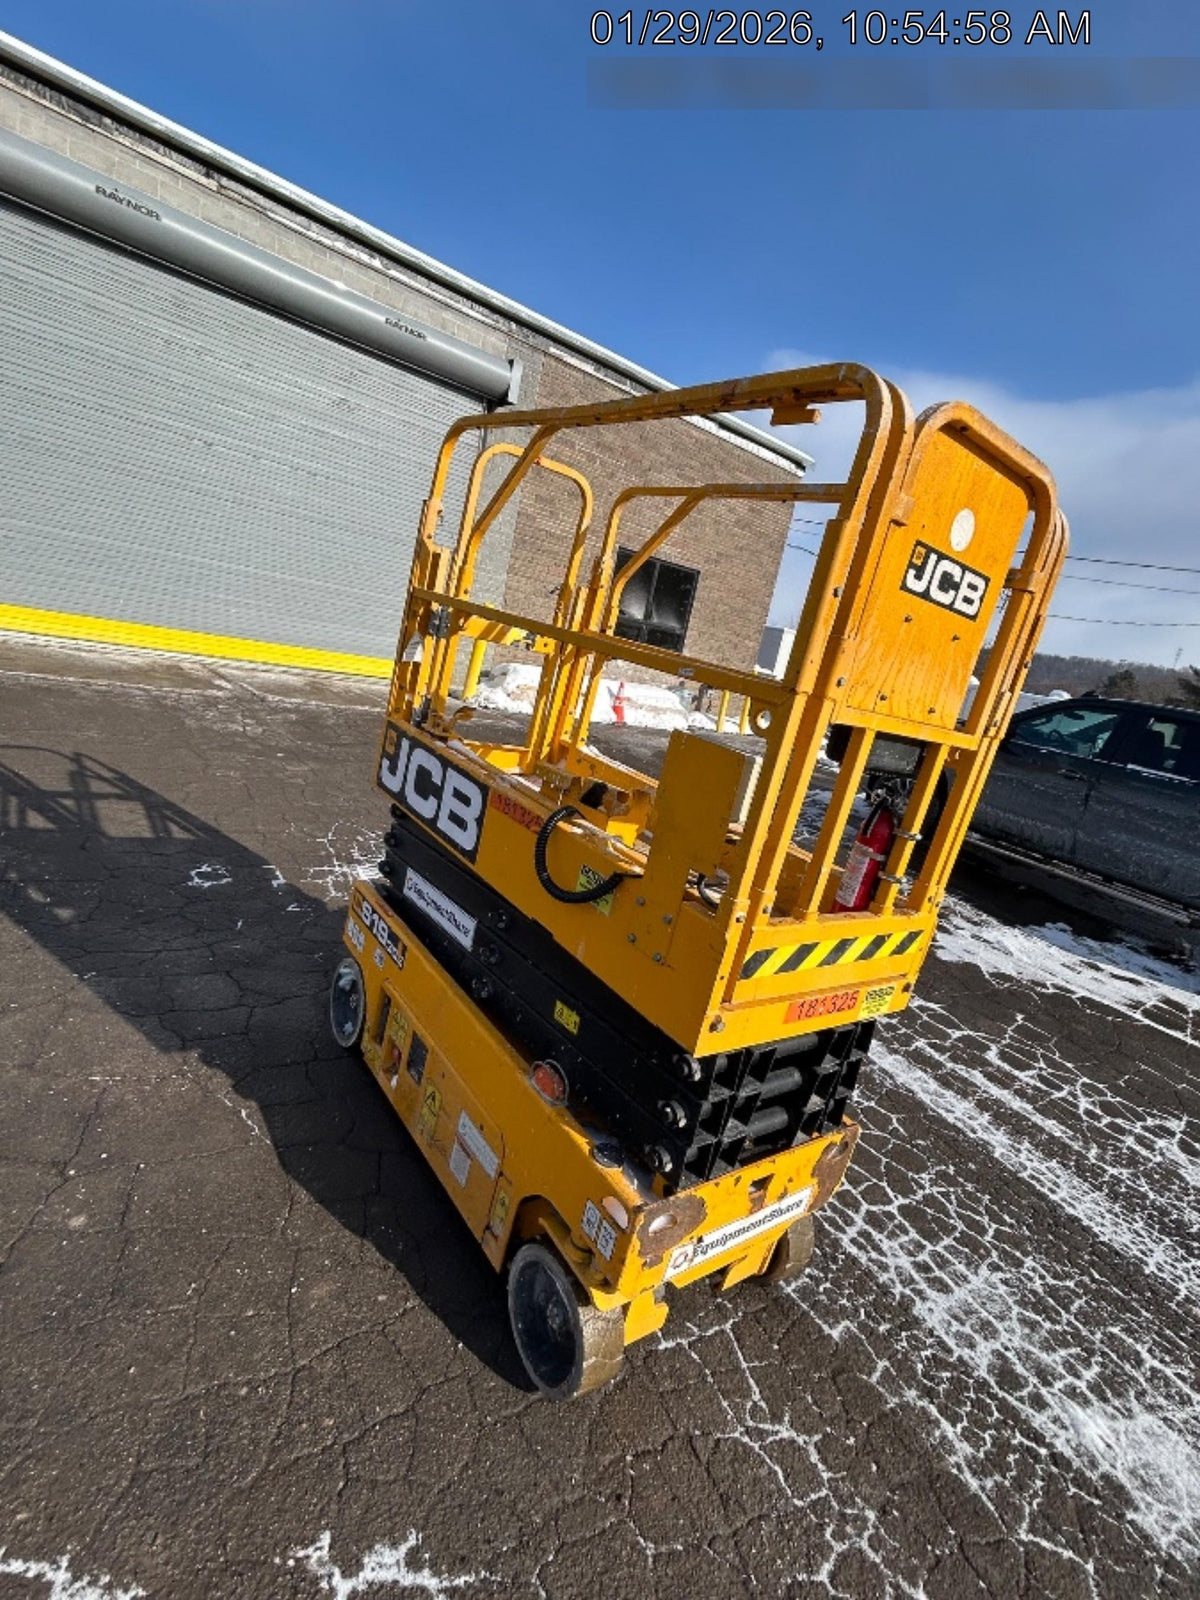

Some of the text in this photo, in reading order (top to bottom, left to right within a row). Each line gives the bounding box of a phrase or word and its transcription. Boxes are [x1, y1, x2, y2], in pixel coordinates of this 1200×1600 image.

[95, 185, 162, 221] RAYNOR
[905, 552, 986, 616] JCB
[381, 737, 484, 851] JCB
